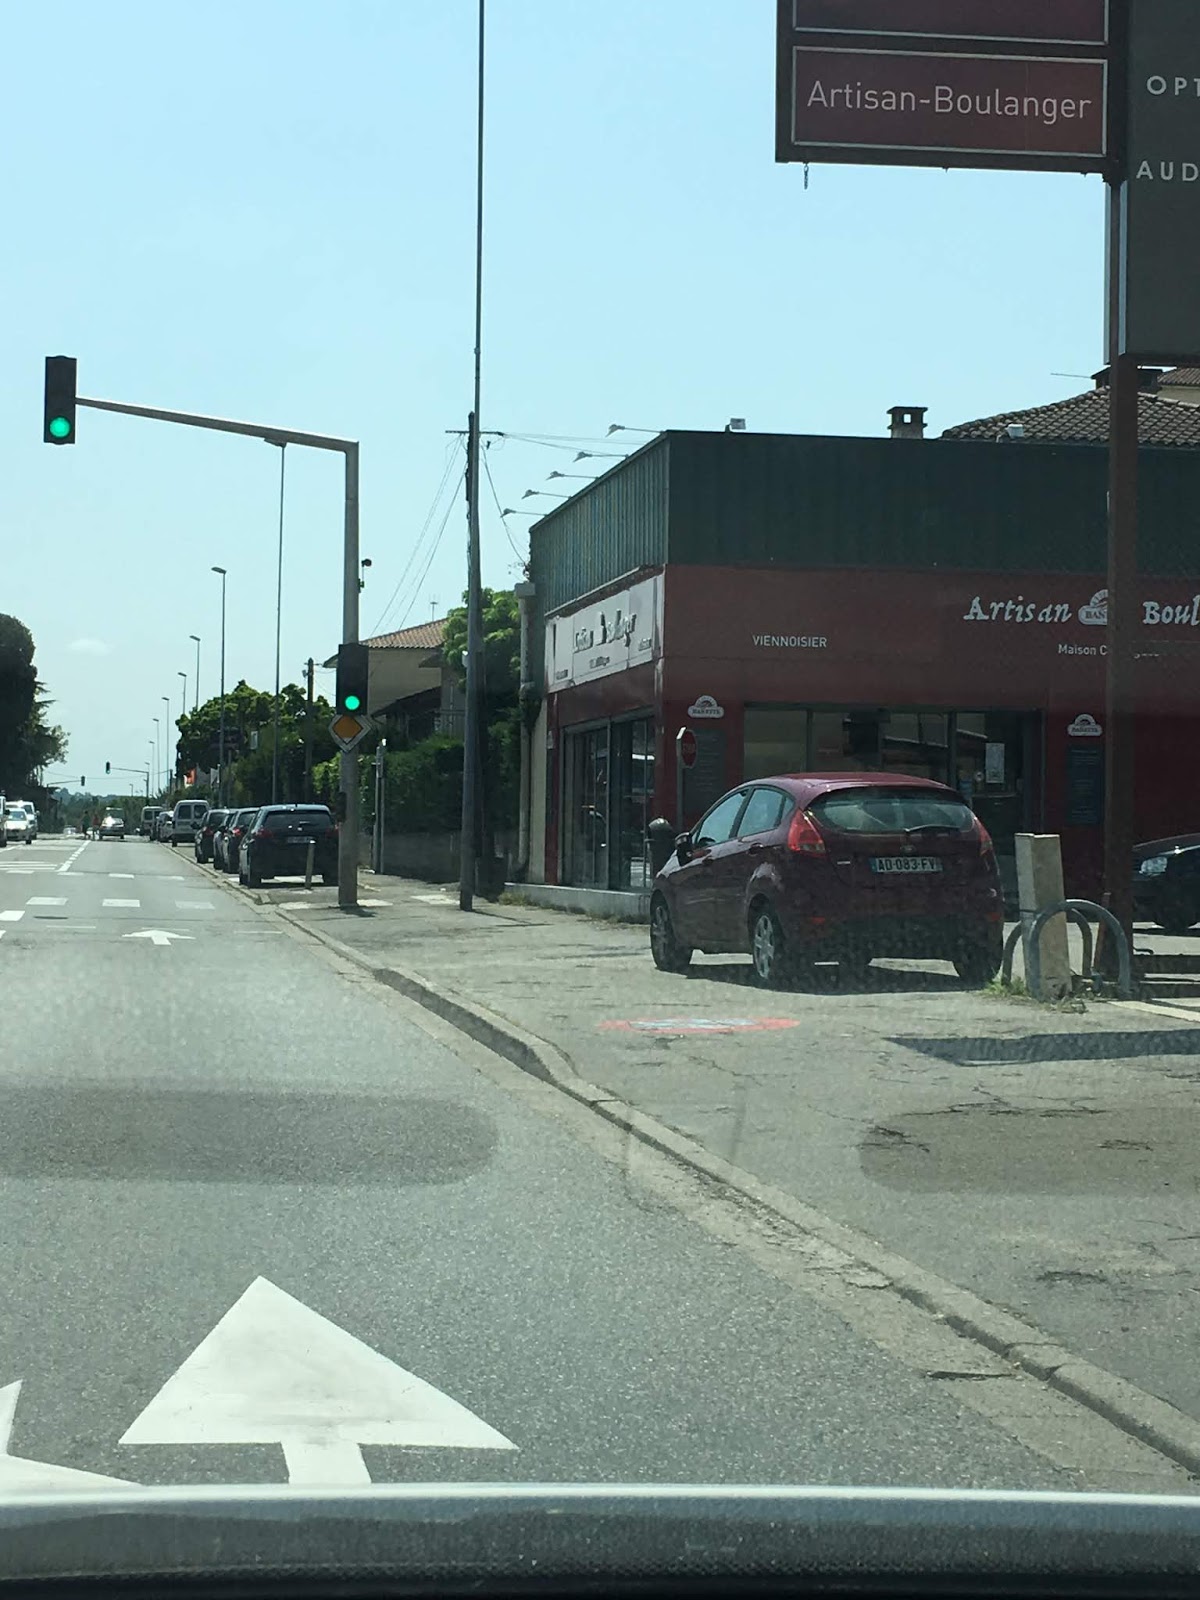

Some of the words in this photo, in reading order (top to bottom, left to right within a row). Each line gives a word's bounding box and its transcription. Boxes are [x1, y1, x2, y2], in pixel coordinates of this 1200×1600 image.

[1146, 75, 1200, 97] OPT
[807, 81, 1092, 125] Artisan-Boulanger
[1136, 160, 1199, 182] AUD
[963, 596, 1072, 623] Artisan
[1142, 594, 1200, 626] Boul
[752, 635, 827, 649] VIENNOISIER
[1058, 643, 1097, 656] Maison
